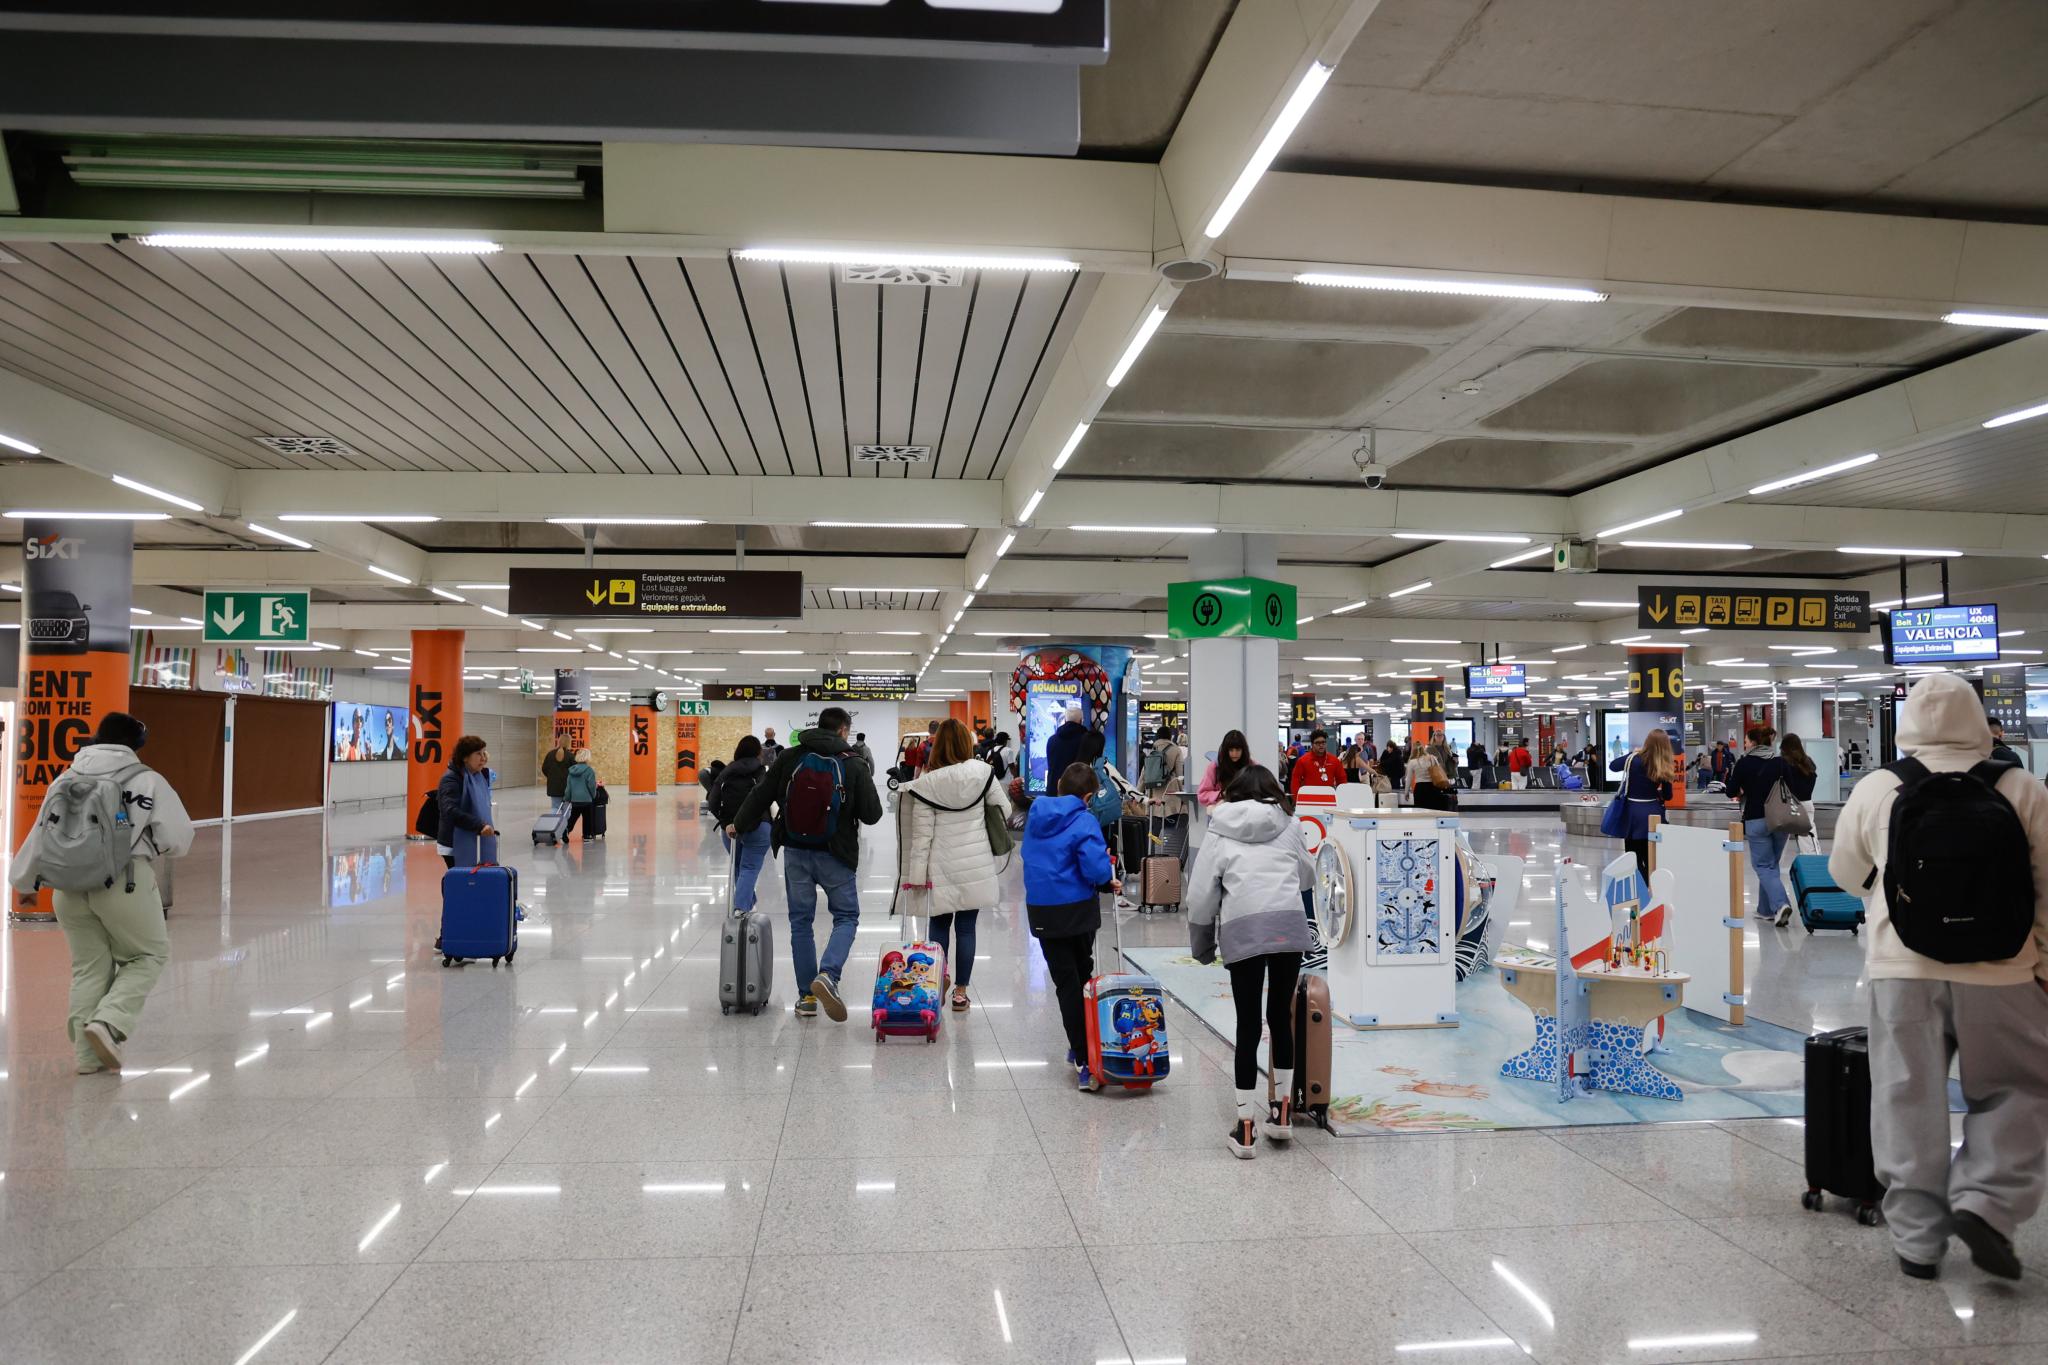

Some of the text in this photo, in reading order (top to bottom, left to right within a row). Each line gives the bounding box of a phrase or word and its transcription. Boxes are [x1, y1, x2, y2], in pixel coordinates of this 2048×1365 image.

[26, 534, 86, 560] SIXT
[641, 573, 726, 584] Equipatges extraviats
[641, 583, 688, 593] Lost luggage
[641, 593, 679, 602] Verlorenes
[1834, 594, 1859, 603] Sortida
[641, 602, 727, 612] Equipajes extraviados
[1834, 603, 1862, 613] Ausgang
[1834, 611, 1847, 620] Exit
[1916, 613, 1931, 625] 17
[1834, 621, 1856, 629] Salida
[1905, 626, 1983, 641] VALENCIA
[1486, 676, 1508, 685] IBIZA
[1646, 666, 1684, 699] 16
[1032, 683, 1078, 694] AQUALAND
[1420, 690, 1445, 713] 15
[57, 701, 91, 716] THE
[1295, 704, 1316, 722] 15
[412, 684, 442, 764] SIXT
[1164, 716, 1178, 729] 14
[17, 718, 92, 761] BIG
[633, 714, 649, 756] SIXT
[571, 740, 585, 748] EIN
